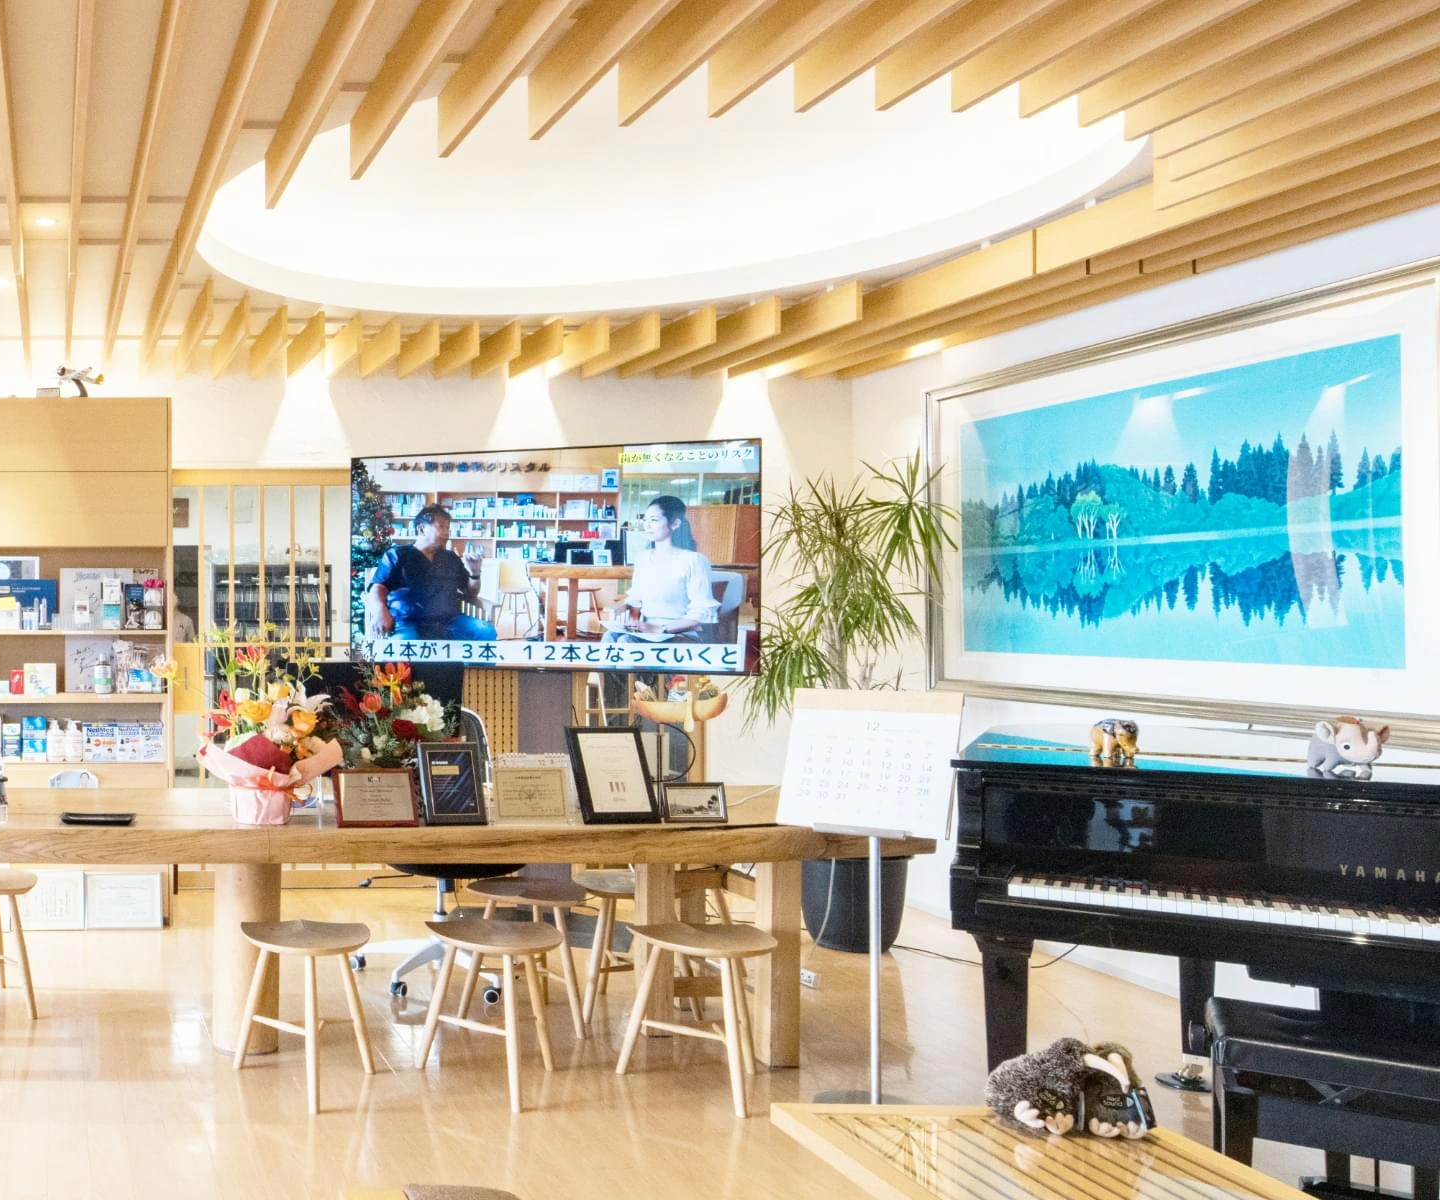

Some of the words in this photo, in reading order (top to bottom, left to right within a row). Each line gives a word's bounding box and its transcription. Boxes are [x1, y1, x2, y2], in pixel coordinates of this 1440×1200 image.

[383, 460, 552, 474] エルム駅前歯科クリスタル
[865, 720, 880, 732] 12
